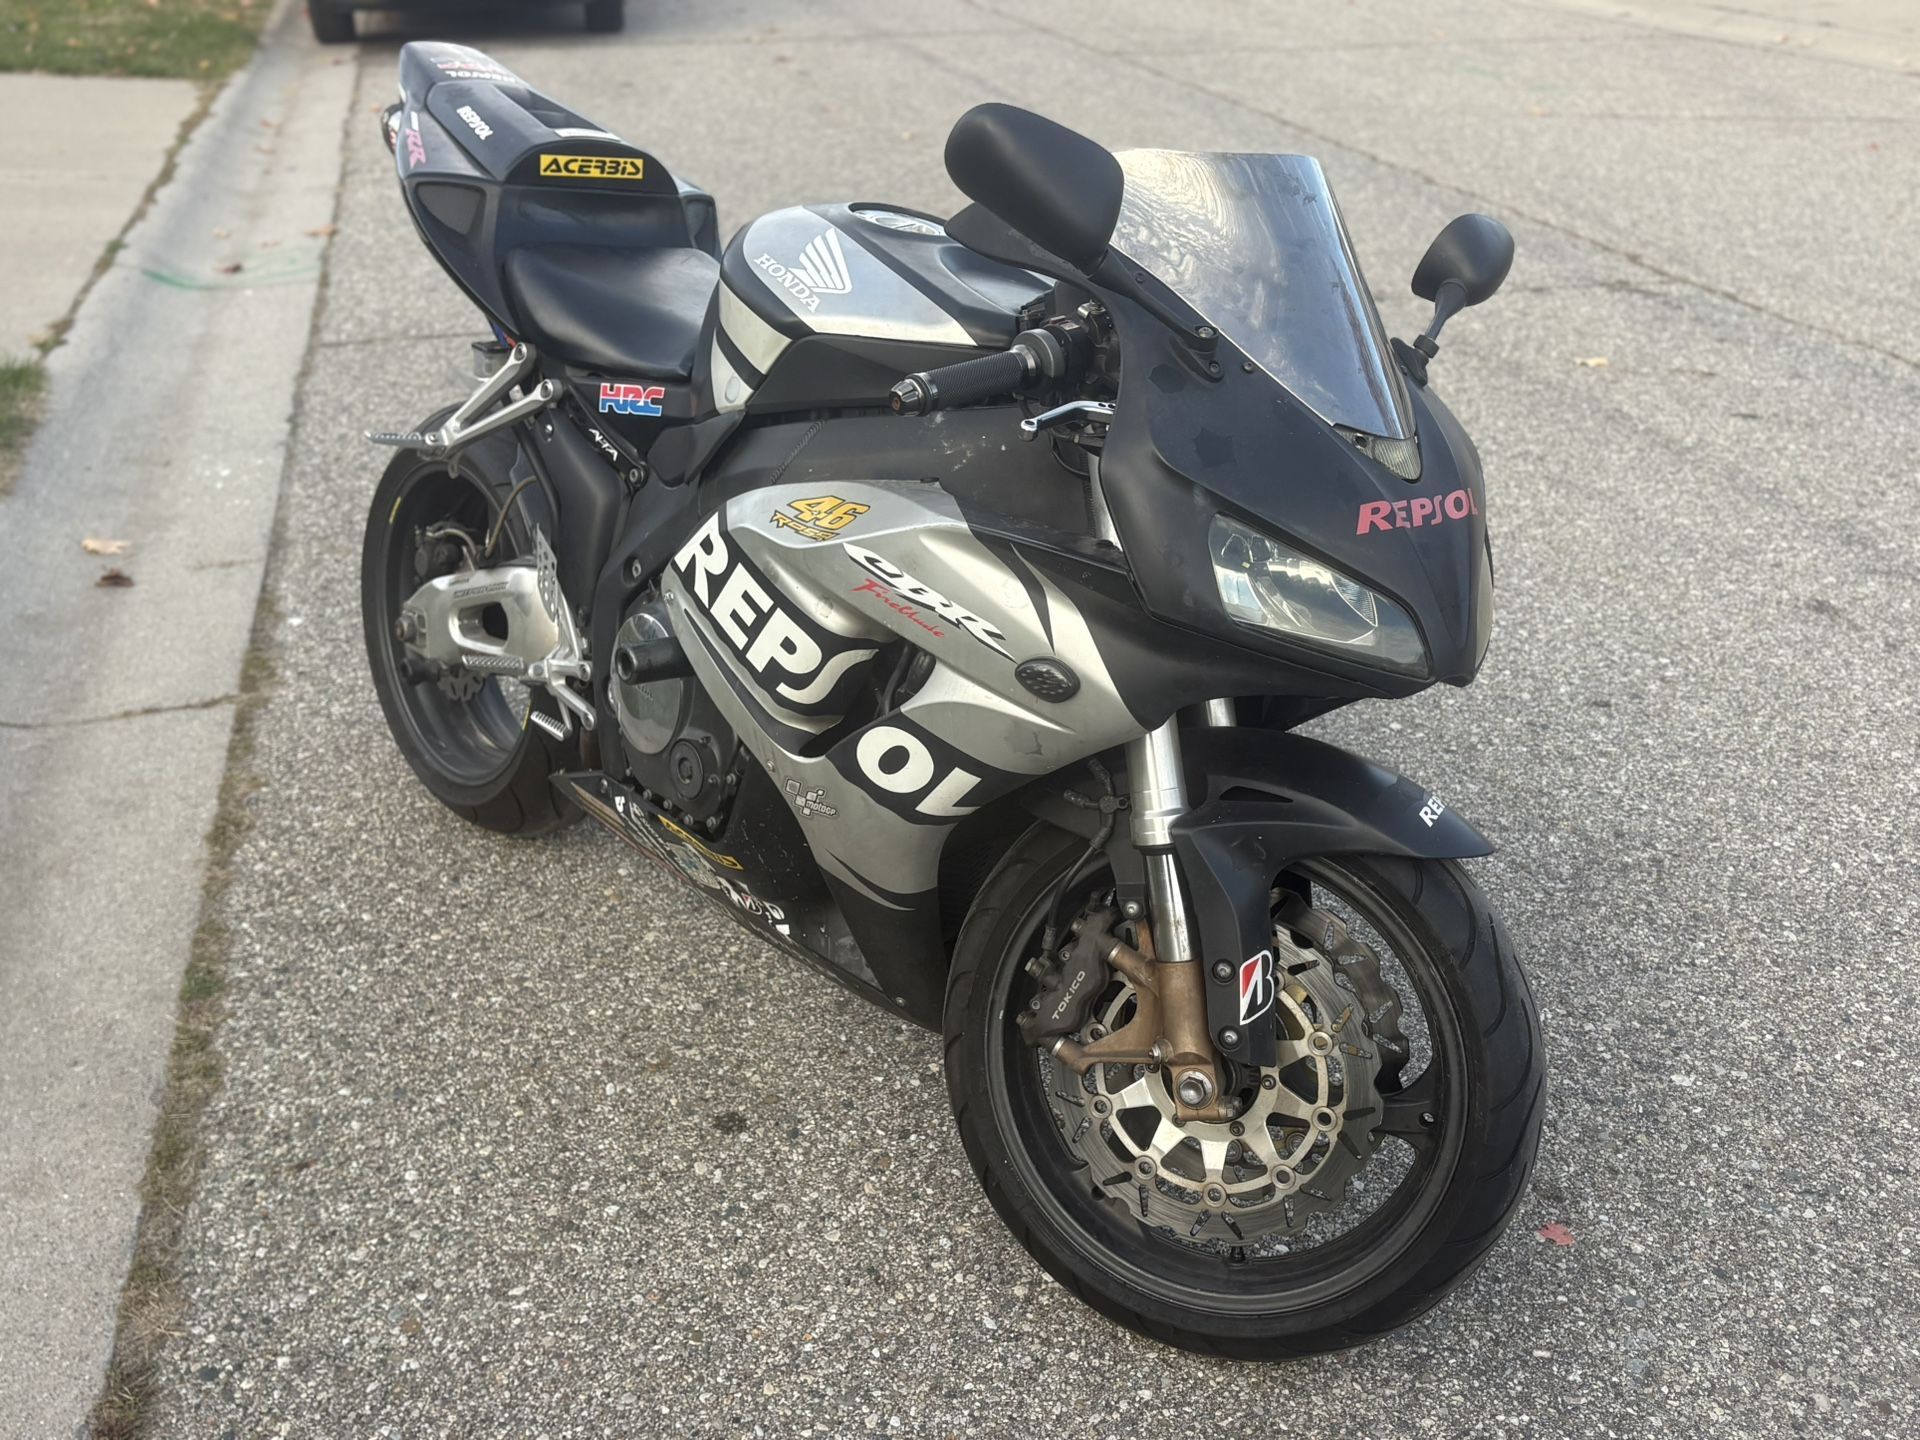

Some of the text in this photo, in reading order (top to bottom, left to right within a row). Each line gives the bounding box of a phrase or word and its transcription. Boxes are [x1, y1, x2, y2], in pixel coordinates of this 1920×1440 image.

[754, 253, 822, 312] HONDA
[598, 382, 666, 417] HRC
[786, 495, 871, 531] 46
[1356, 487, 1479, 536] REPSOL
[1051, 970, 1086, 1020] TOKICO
